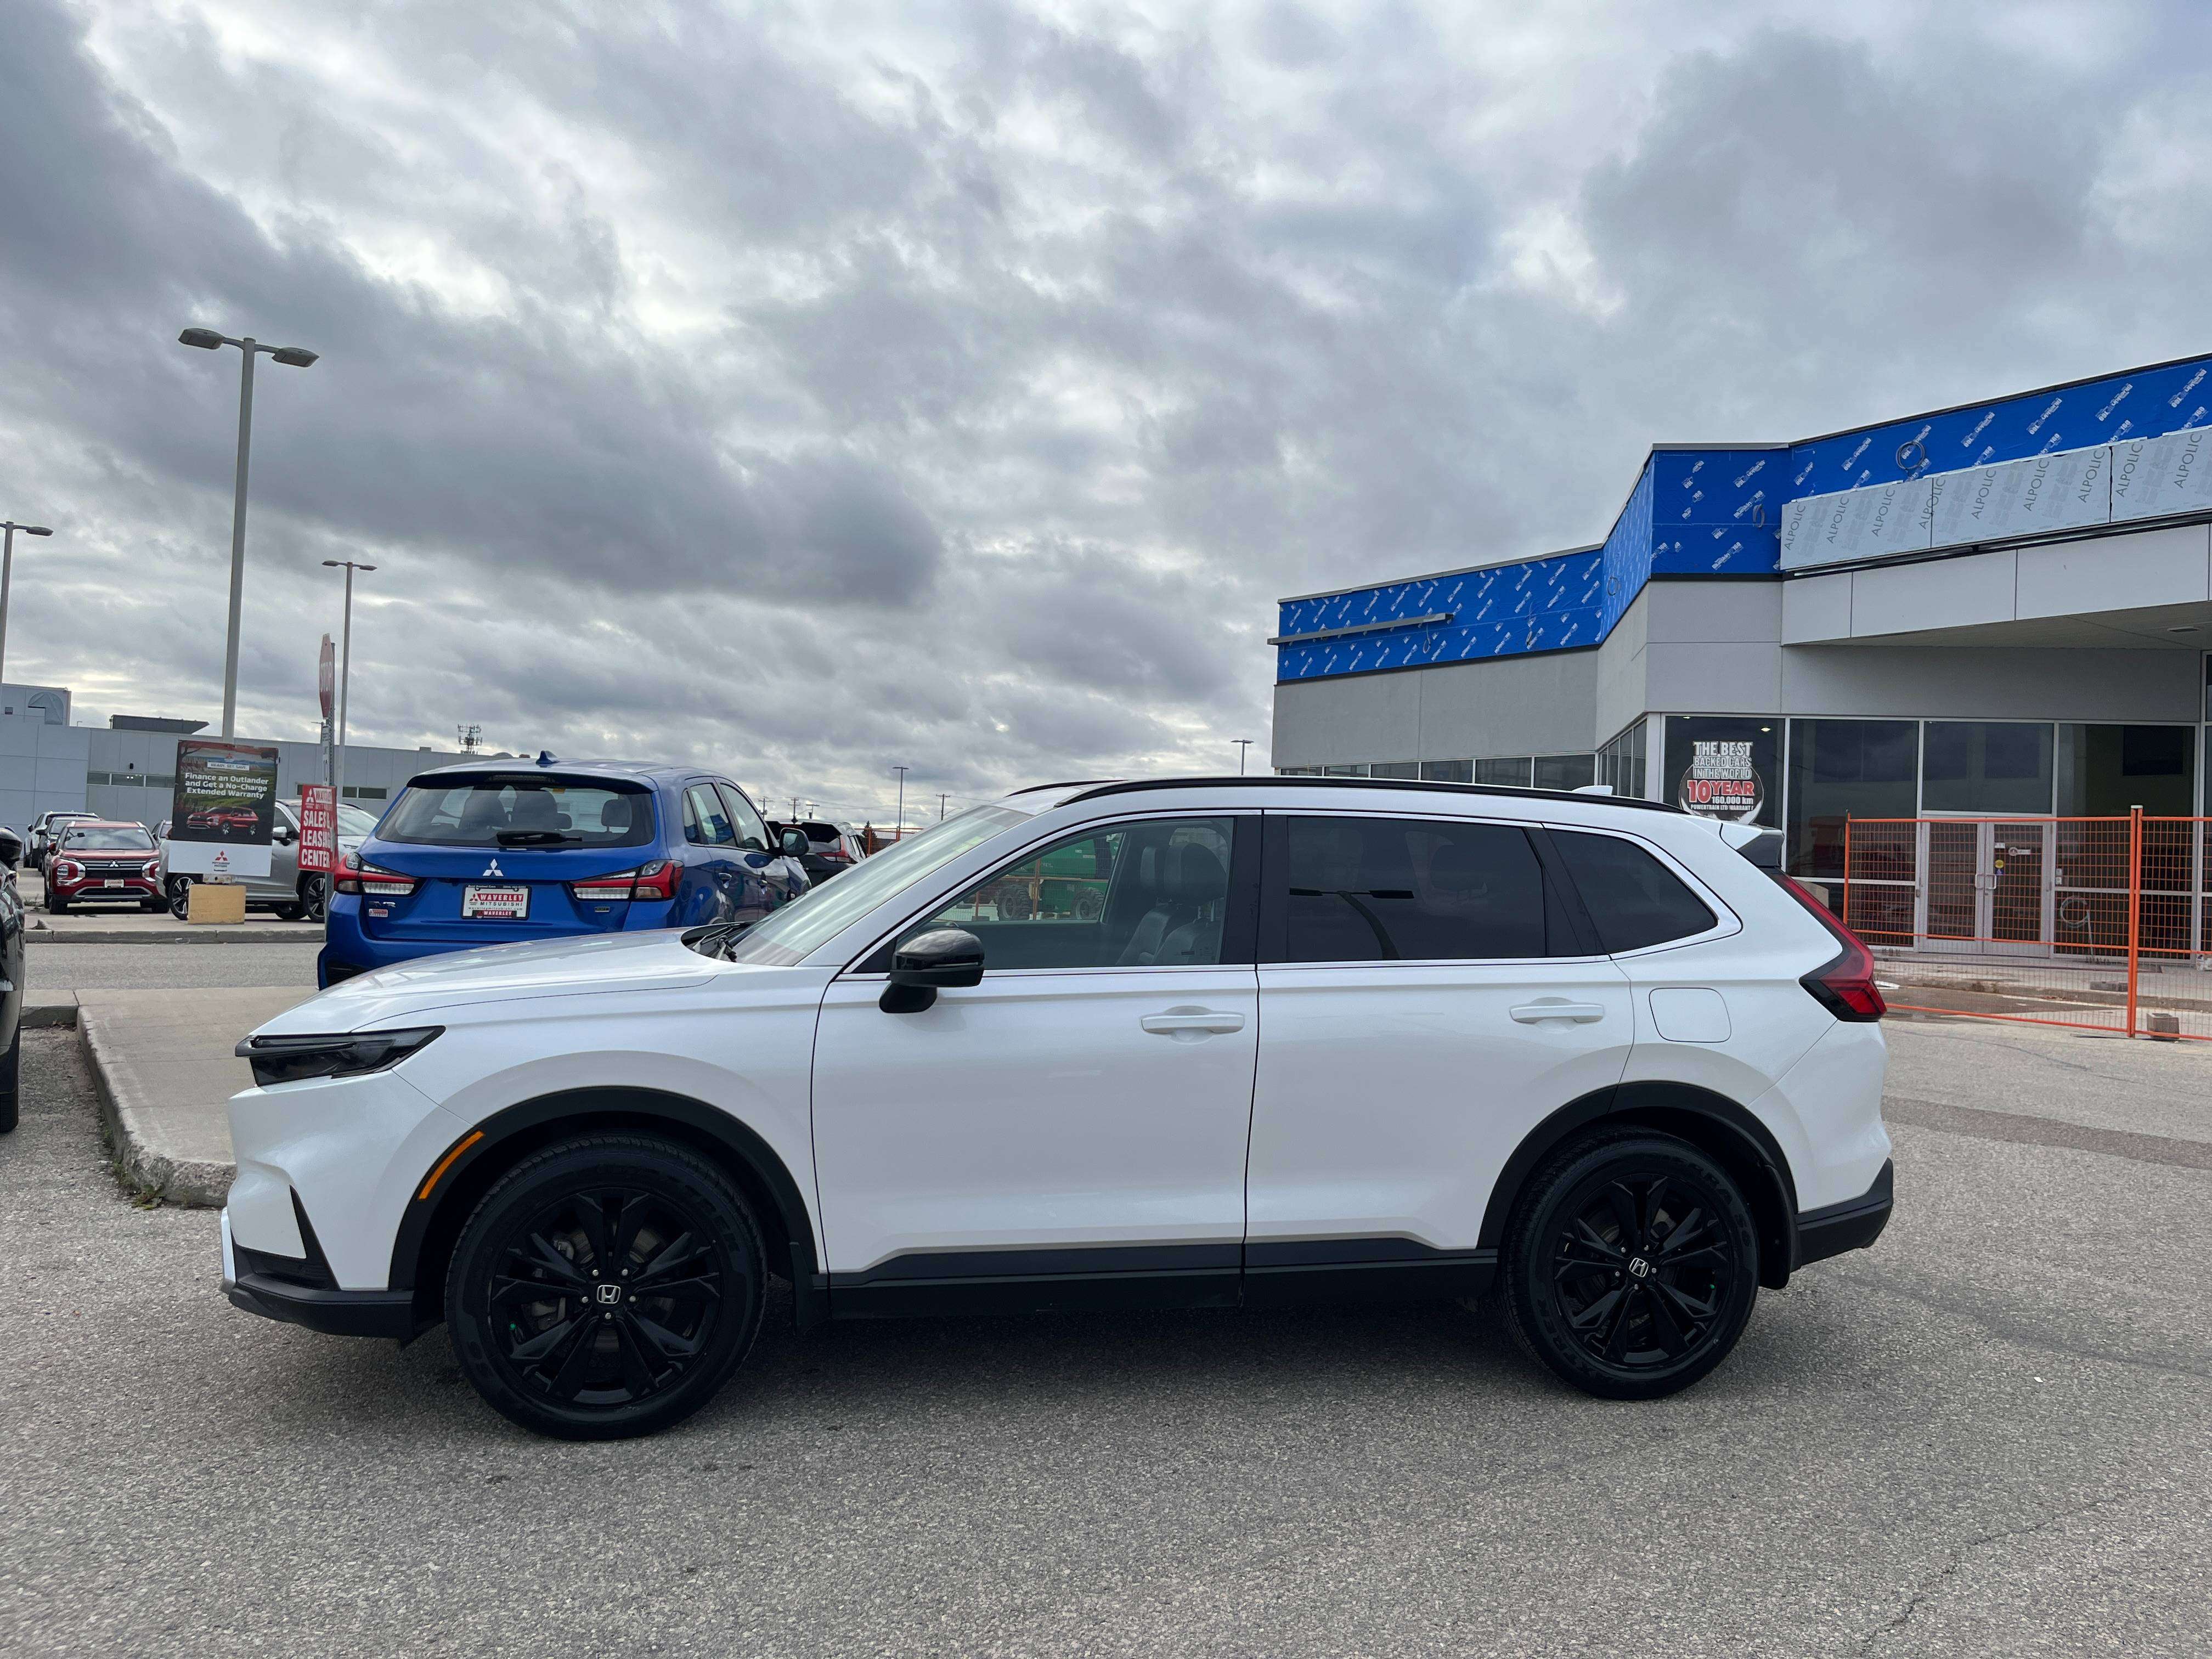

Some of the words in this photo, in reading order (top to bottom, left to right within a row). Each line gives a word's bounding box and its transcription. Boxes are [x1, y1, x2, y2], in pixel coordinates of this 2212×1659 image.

[2115, 443, 2143, 498] ALPOLIC
[2174, 433, 2203, 488] ALPOLIC
[2023, 460, 2050, 511] ALPOLIC
[2078, 450, 2105, 503] ALPOLIC
[1918, 477, 1946, 529] ALPOLIC
[1971, 469, 1996, 520] ALPOLIC
[1826, 496, 1849, 544] ALPOLIC
[1871, 488, 1895, 537] ALPOLIC
[1784, 504, 1806, 550] ALPOLIC
[320, 661, 332, 692] STOP
[1694, 742, 1718, 756] THE
[1720, 742, 1752, 757] BEST
[1694, 757, 1726, 767] BACKED
[1729, 757, 1752, 767] CARS
[1694, 768, 1702, 778] IN
[1703, 768, 1720, 778] THE
[1721, 768, 1752, 778] WORLD
[185, 772, 217, 781] Finance
[230, 776, 269, 785] Outlander
[226, 782, 268, 793] No-Charge
[187, 787, 226, 795] Extended
[228, 790, 264, 799] Warranty
[1687, 780, 1712, 803] 10
[1710, 781, 1754, 795] YEAR
[1712, 796, 1740, 804] 160,000
[303, 810, 326, 828] SALES
[302, 830, 331, 849] LEASING
[302, 849, 330, 868] CENTER
